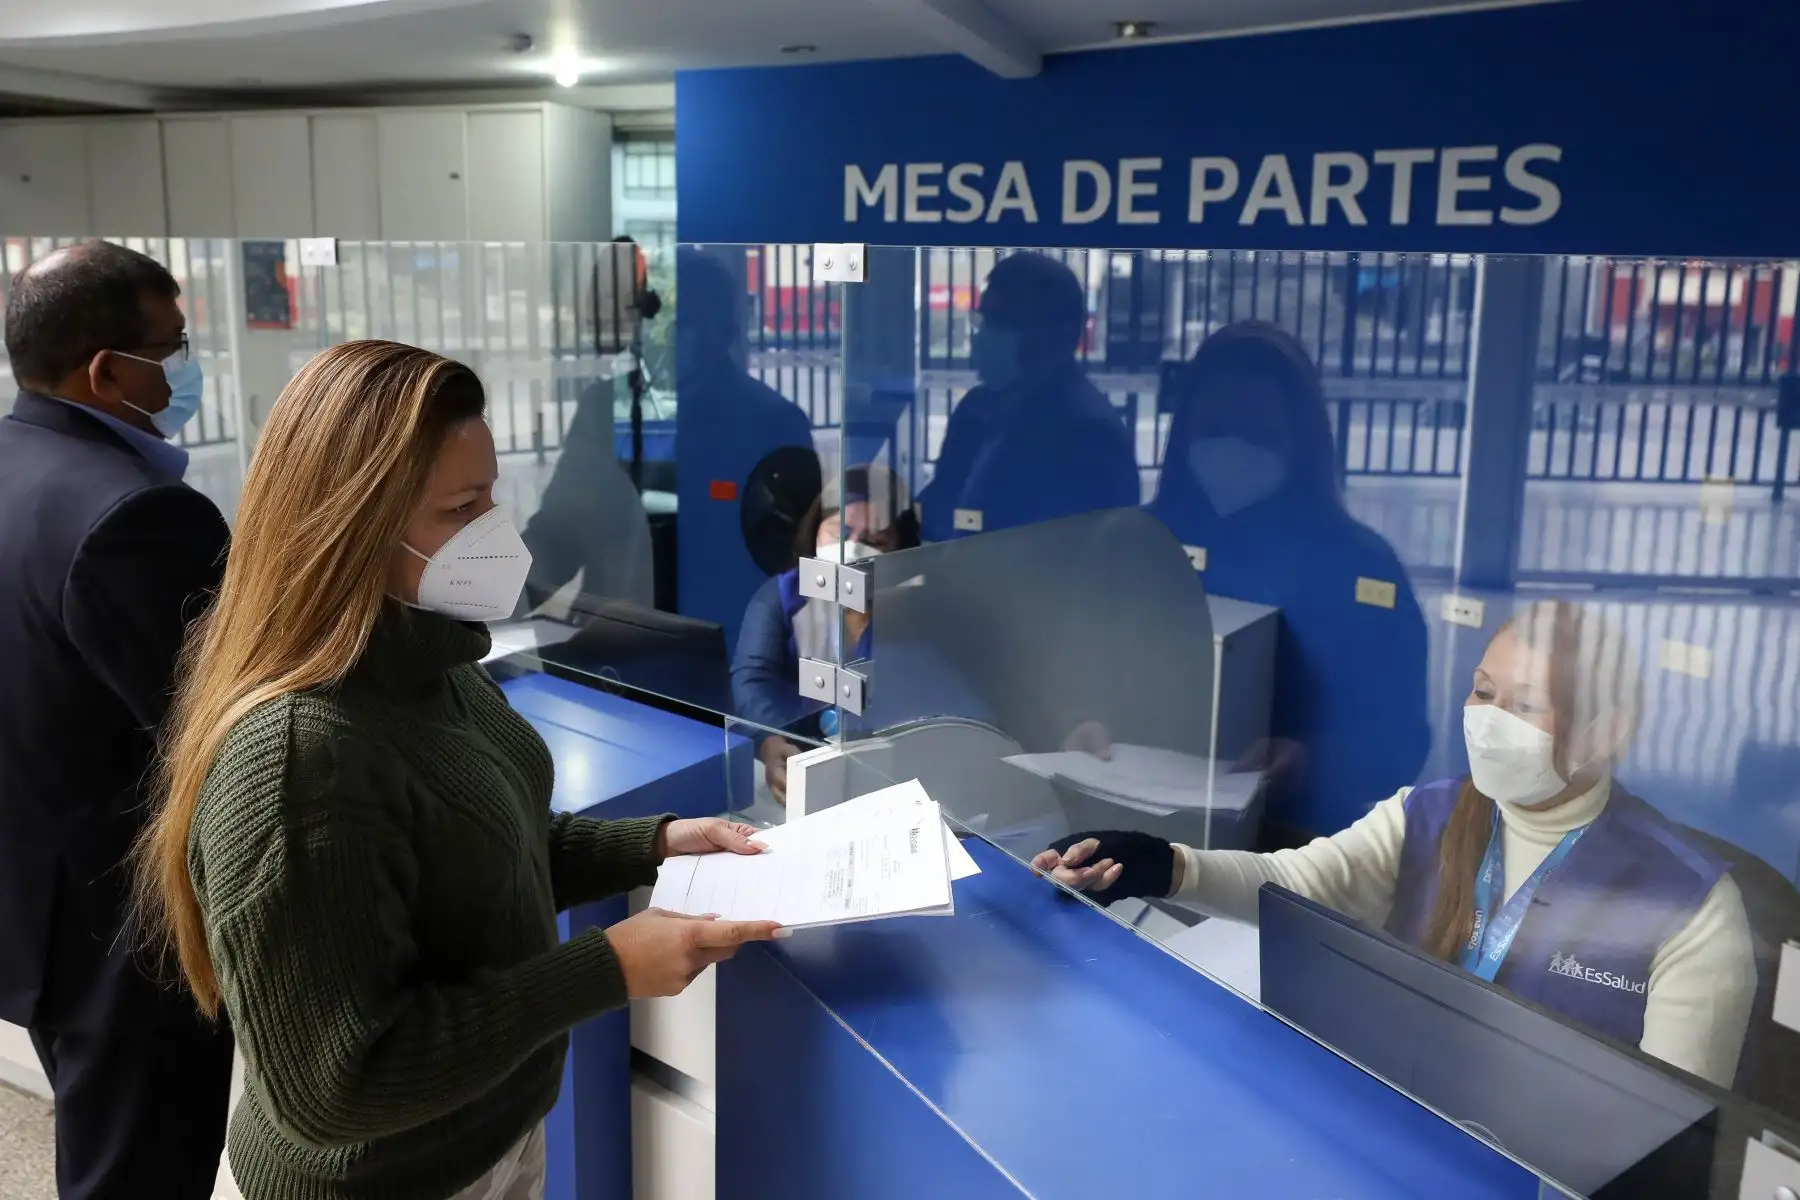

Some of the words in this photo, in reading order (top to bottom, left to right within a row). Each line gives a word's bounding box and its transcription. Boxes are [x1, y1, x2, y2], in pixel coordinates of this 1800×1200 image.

[844, 161, 1038, 223] MESA
[1061, 158, 1162, 224] DE
[1187, 143, 1562, 227] PARTES
[1474, 910, 1483, 929] Una
[1585, 967, 1646, 994] EsSalud
